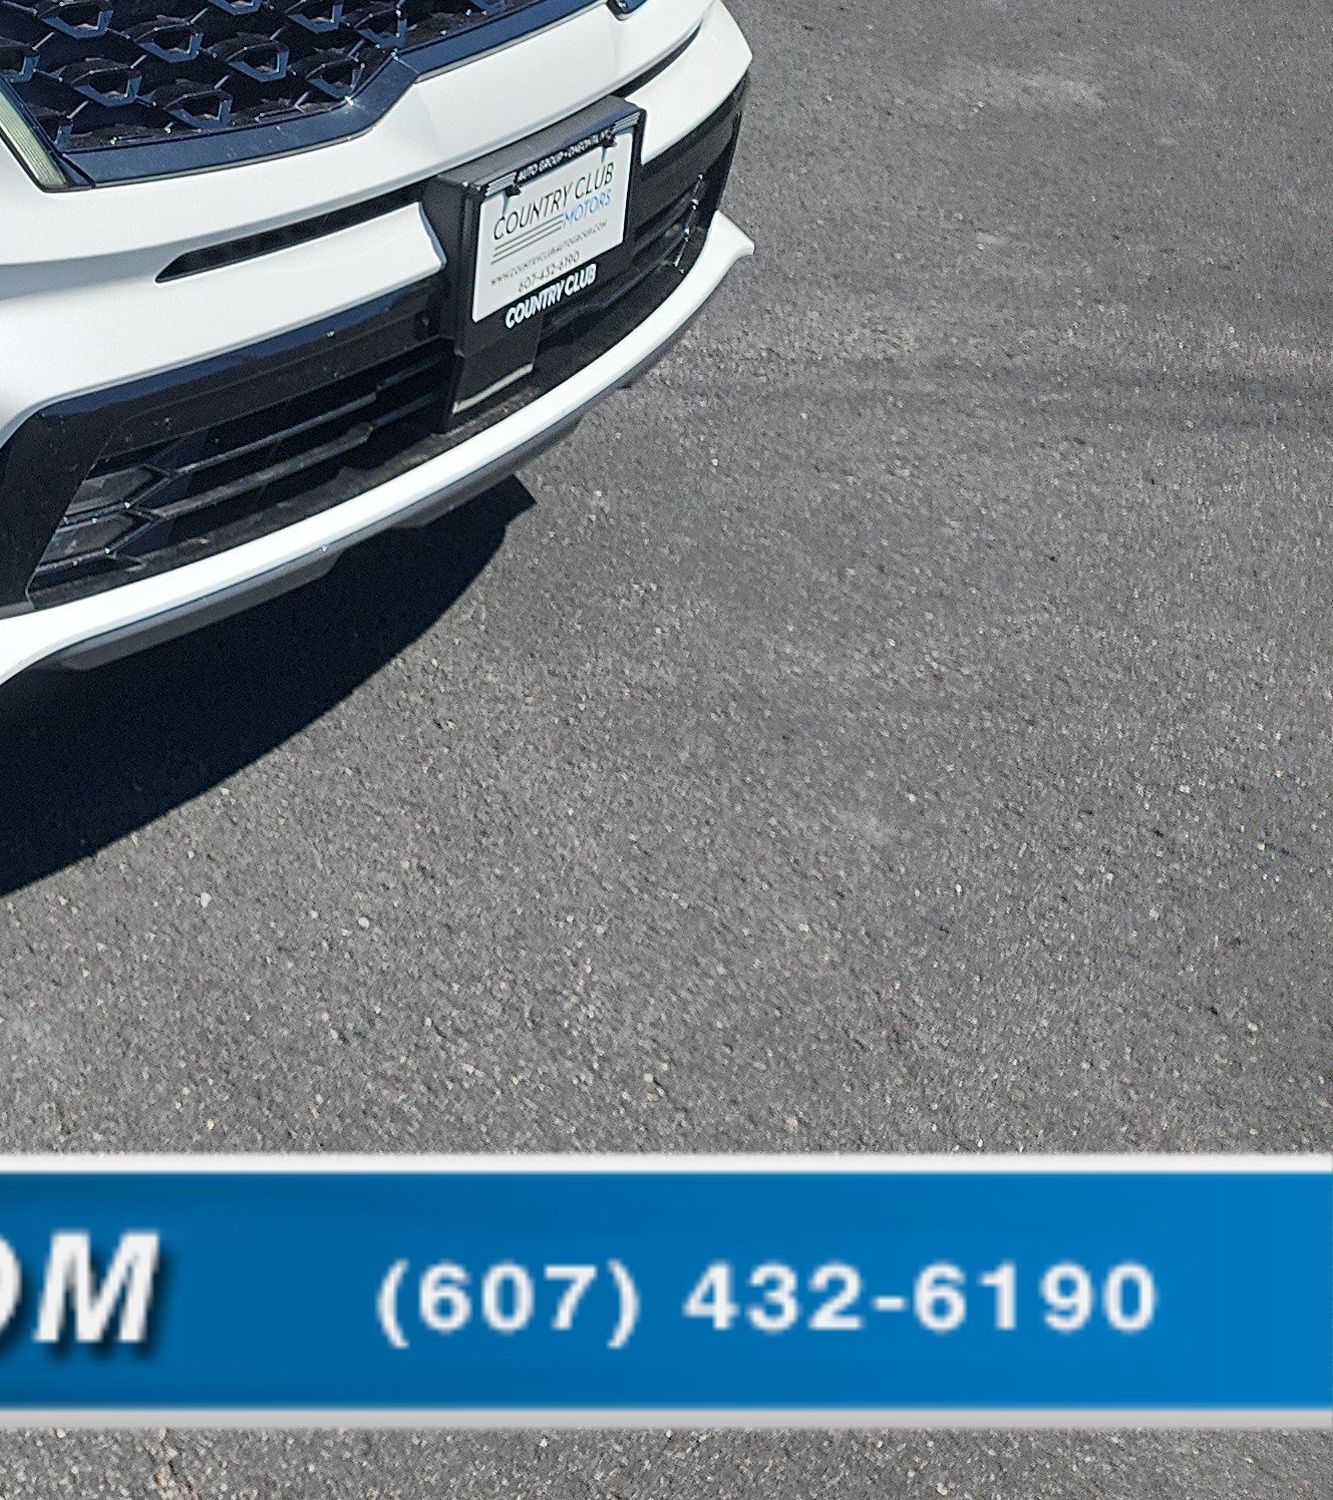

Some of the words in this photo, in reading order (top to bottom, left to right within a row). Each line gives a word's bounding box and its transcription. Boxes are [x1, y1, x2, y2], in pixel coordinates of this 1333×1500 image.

[493, 182, 573, 241] COUNTRY
[574, 161, 615, 200] CLUB
[562, 187, 612, 228] MOTORS
[505, 279, 566, 329] COUNTRY
[564, 263, 597, 297] CLUB
